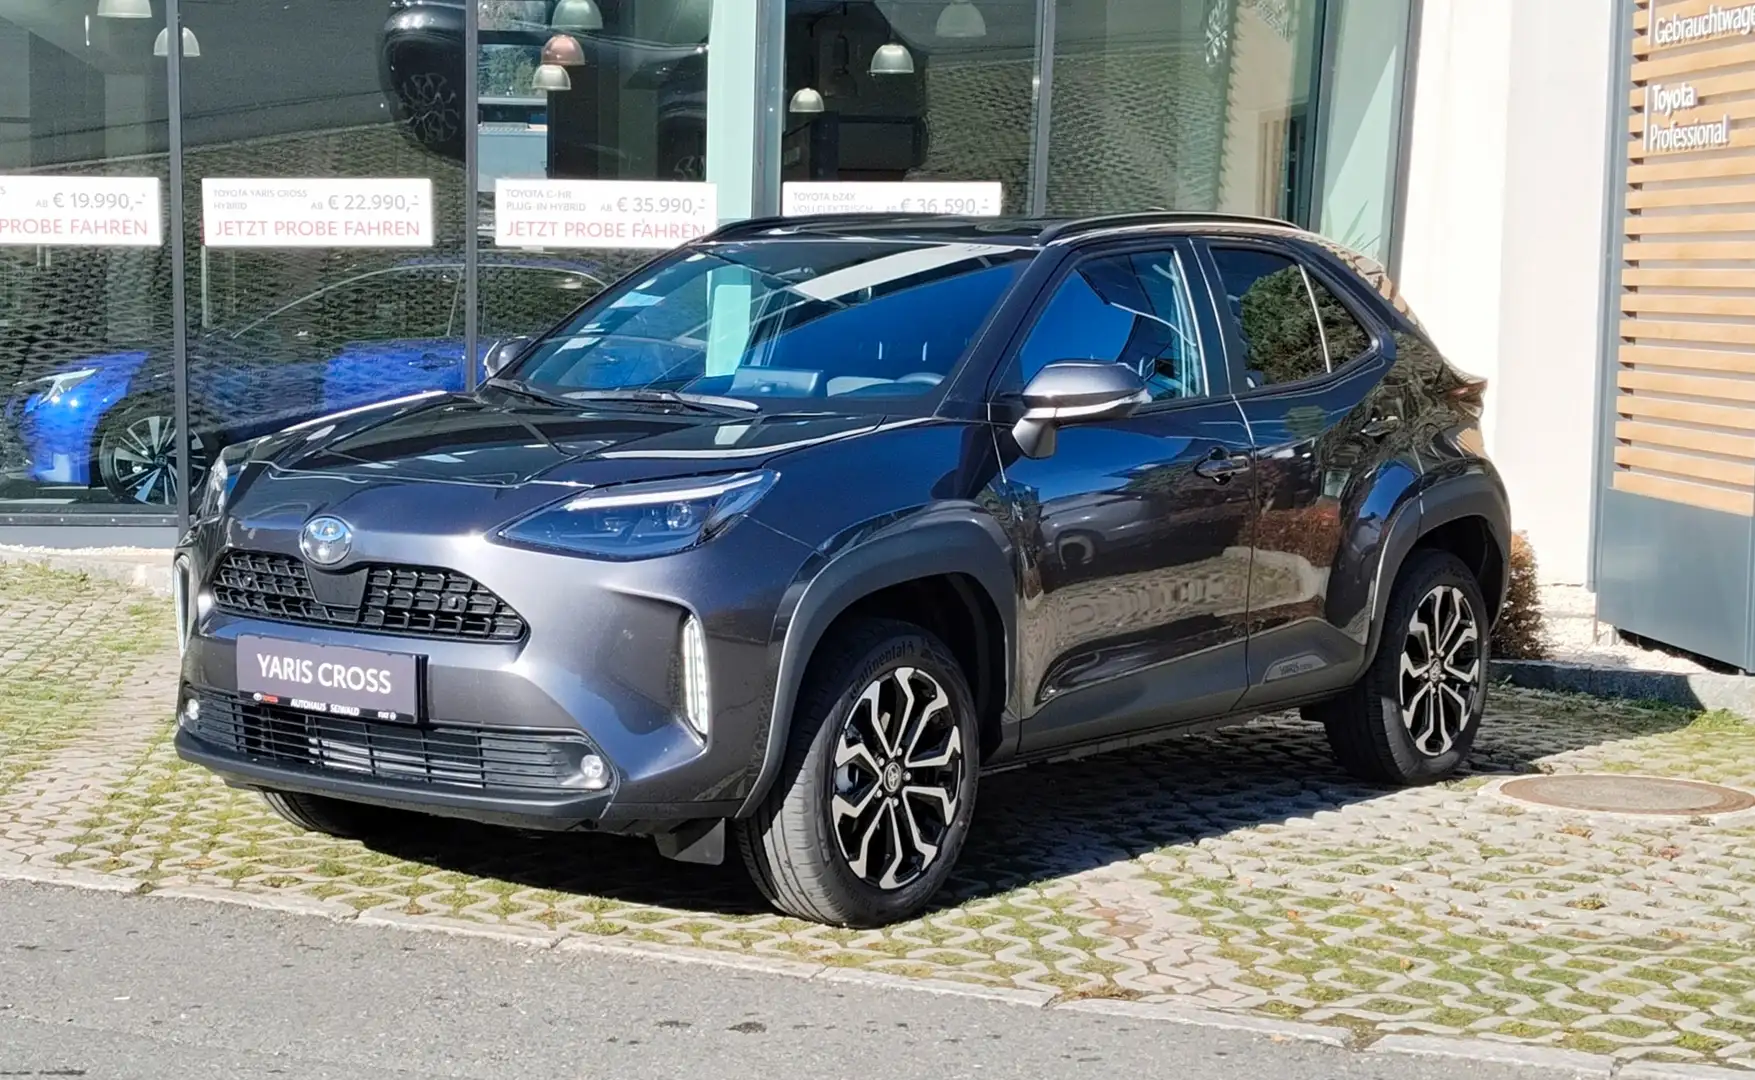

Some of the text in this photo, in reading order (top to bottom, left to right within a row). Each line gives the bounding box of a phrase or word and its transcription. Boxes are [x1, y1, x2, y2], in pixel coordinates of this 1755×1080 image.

[1652, 83, 1695, 117] Toyota
[1650, 114, 1728, 150] Professional
[35, 198, 49, 208] AB
[52, 192, 65, 208] €
[213, 188, 308, 199] TOYOTA YARIS CROSS
[505, 188, 572, 199] TOYOTA C-HR
[793, 191, 857, 201] TOYOTA bZ4X
[213, 202, 248, 211] HYBRID
[310, 201, 323, 210] AB
[328, 194, 339, 210] €
[549, 202, 587, 212] HYBRID
[600, 204, 613, 212] AB
[617, 196, 628, 213] €
[0, 218, 148, 236] PROBE FAHREN
[215, 220, 420, 236] JETZT PROBE FAHREN
[506, 220, 706, 239] JETZT PROBE FAHREN
[257, 652, 392, 694] YARIS CROSS
[290, 698, 327, 712] AUTOHAUS
